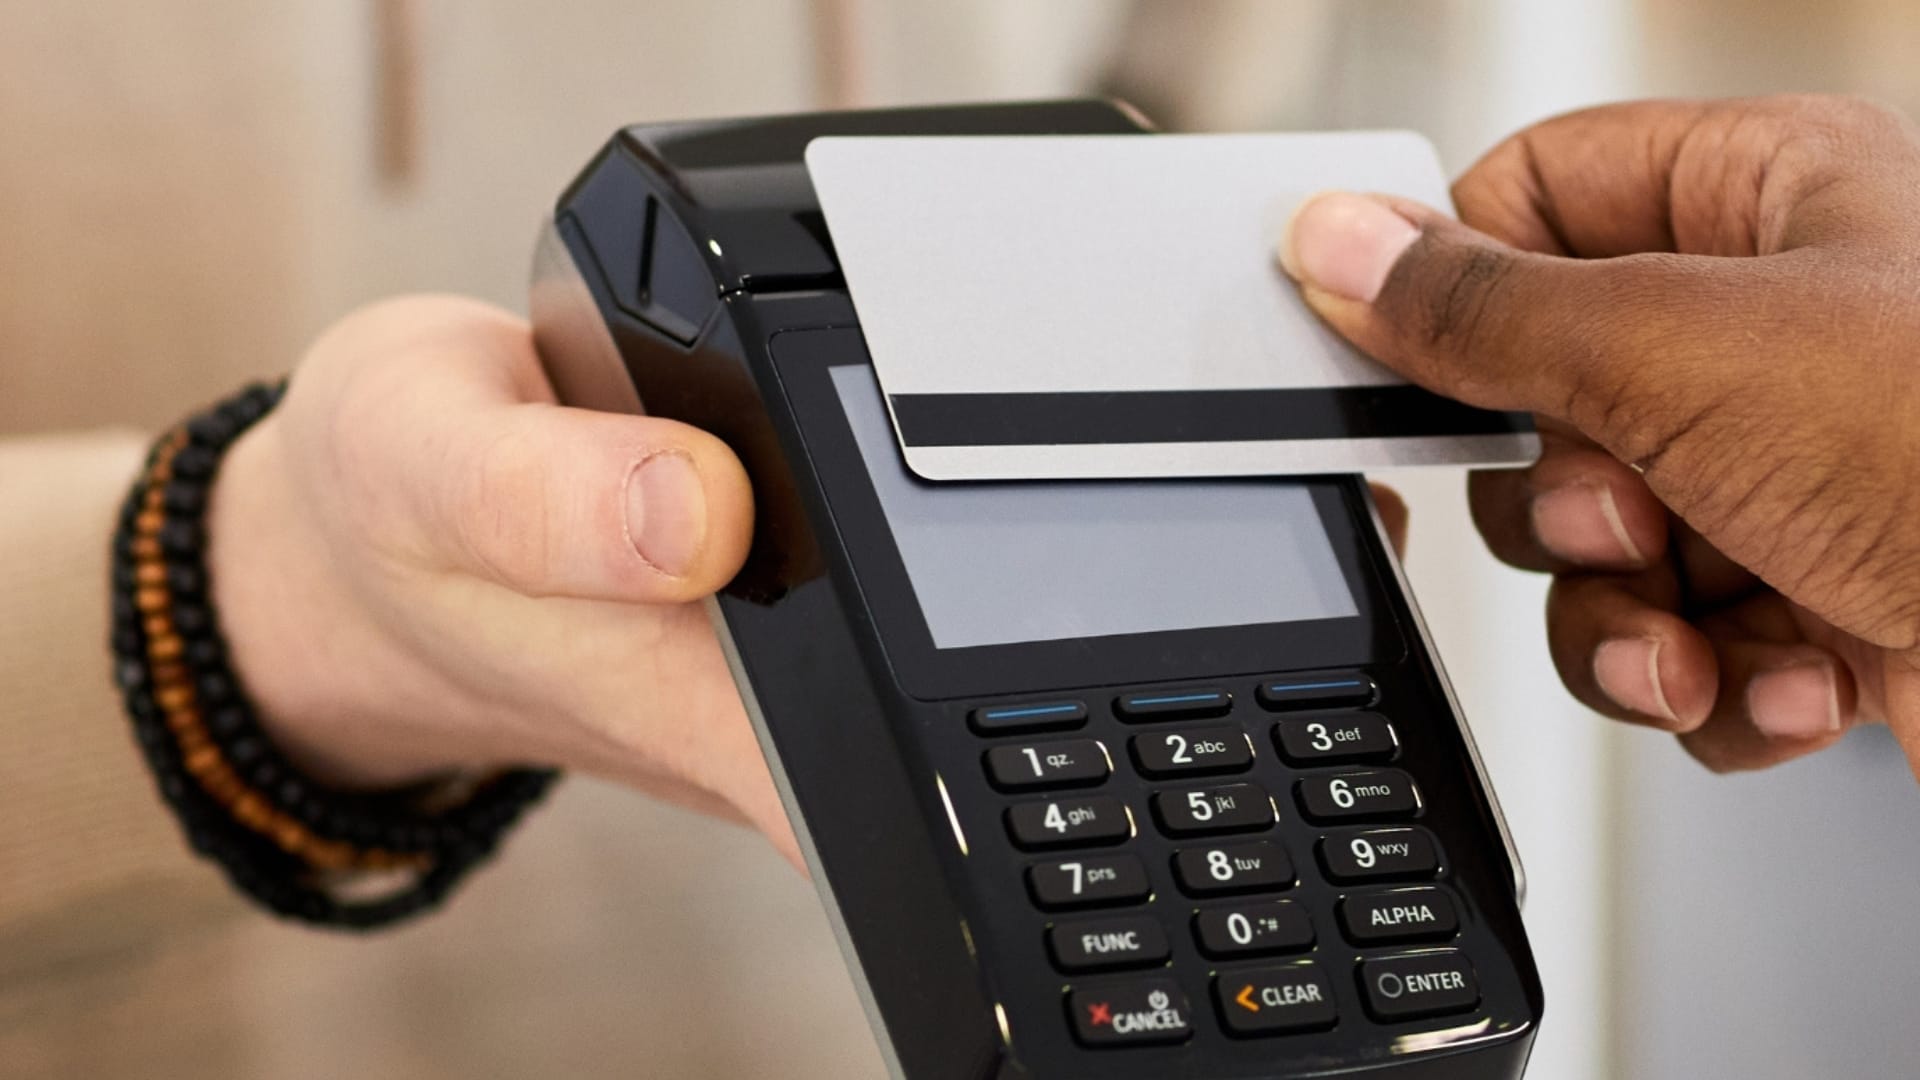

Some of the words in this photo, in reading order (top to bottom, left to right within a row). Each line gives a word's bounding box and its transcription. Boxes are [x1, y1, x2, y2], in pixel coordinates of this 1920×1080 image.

[1165, 734, 1193, 764] 2
[1193, 740, 1226, 754] abc
[1306, 723, 1333, 751] 3
[1334, 727, 1361, 742] def
[1022, 747, 1043, 777] 1
[1187, 791, 1213, 821] 5
[1215, 796, 1236, 813] jkl
[1329, 779, 1355, 808] 6
[1354, 785, 1391, 797] mno
[1044, 803, 1068, 833] 4
[1067, 807, 1096, 826] ghi
[1207, 850, 1234, 881] 8
[1234, 858, 1261, 871] tuv
[1350, 838, 1376, 868] 9
[1376, 843, 1409, 857] wxy
[1059, 862, 1082, 894] 7
[1086, 868, 1116, 883] prs
[1227, 912, 1252, 945] 0
[1371, 905, 1436, 926] ALPHA
[1082, 931, 1140, 953] FUNC
[1261, 983, 1322, 1007] CLEAR
[1405, 971, 1465, 993] ENTER
[1112, 1009, 1186, 1034] CANCEL
